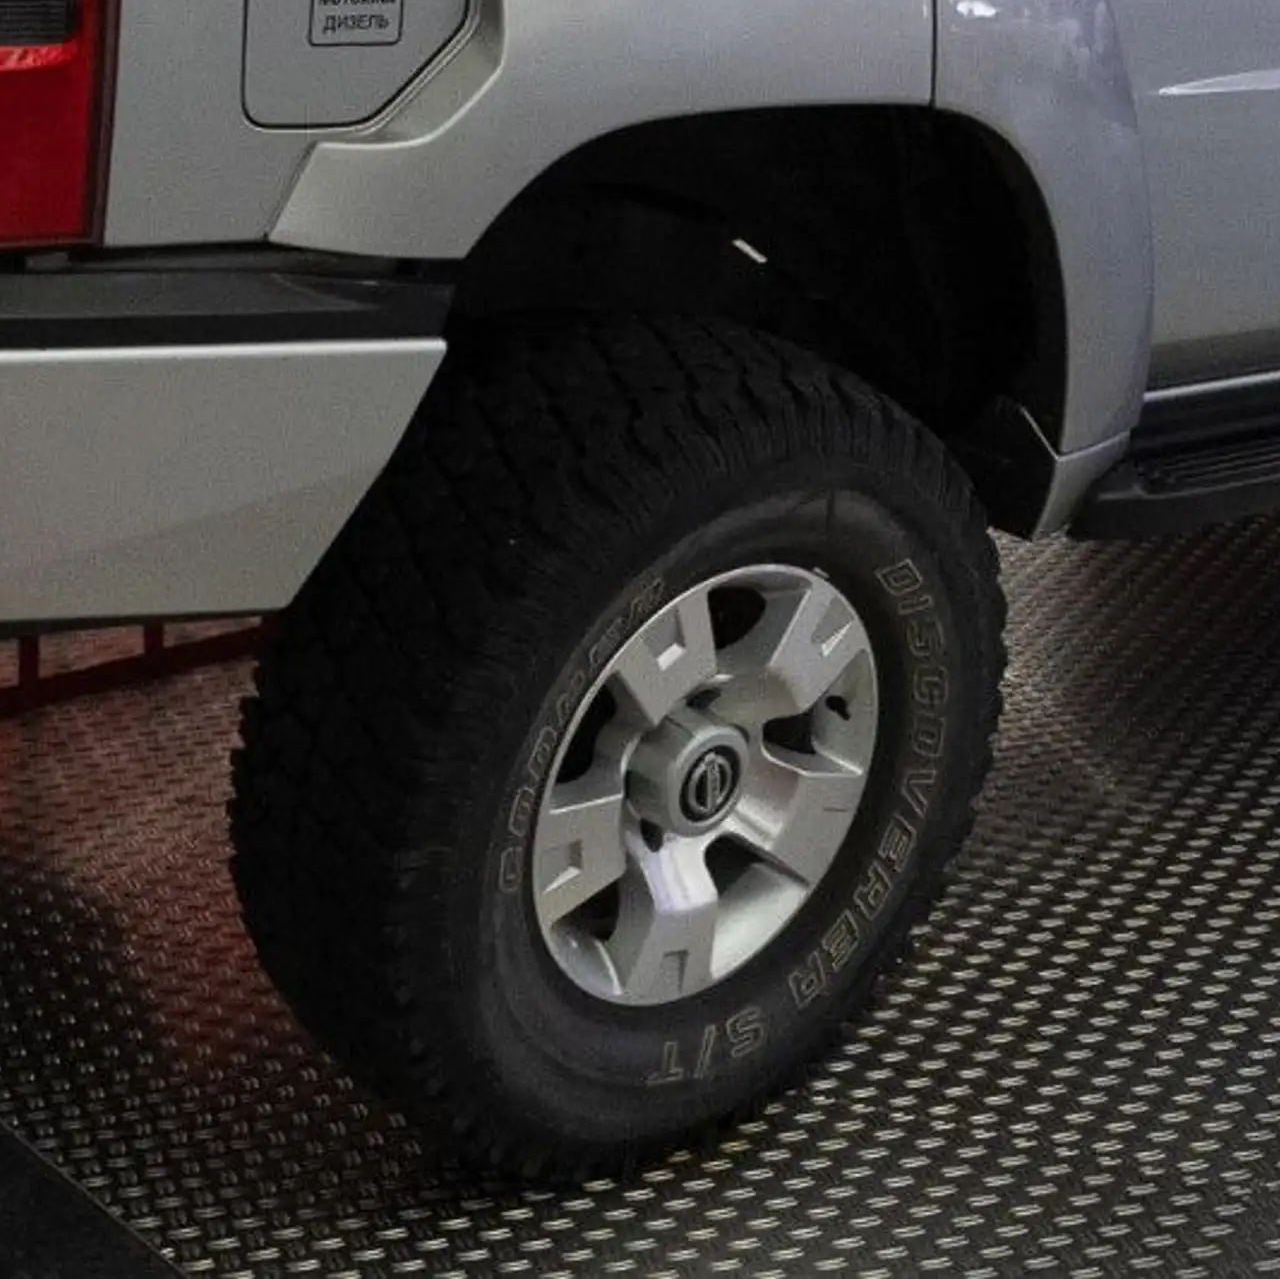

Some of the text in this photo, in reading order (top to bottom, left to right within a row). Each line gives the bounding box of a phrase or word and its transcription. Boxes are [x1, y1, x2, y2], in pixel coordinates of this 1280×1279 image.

[322, 13, 390, 34] ДИЗЕЛЬ
[646, 559, 949, 1087] DISCOVERER S/T
